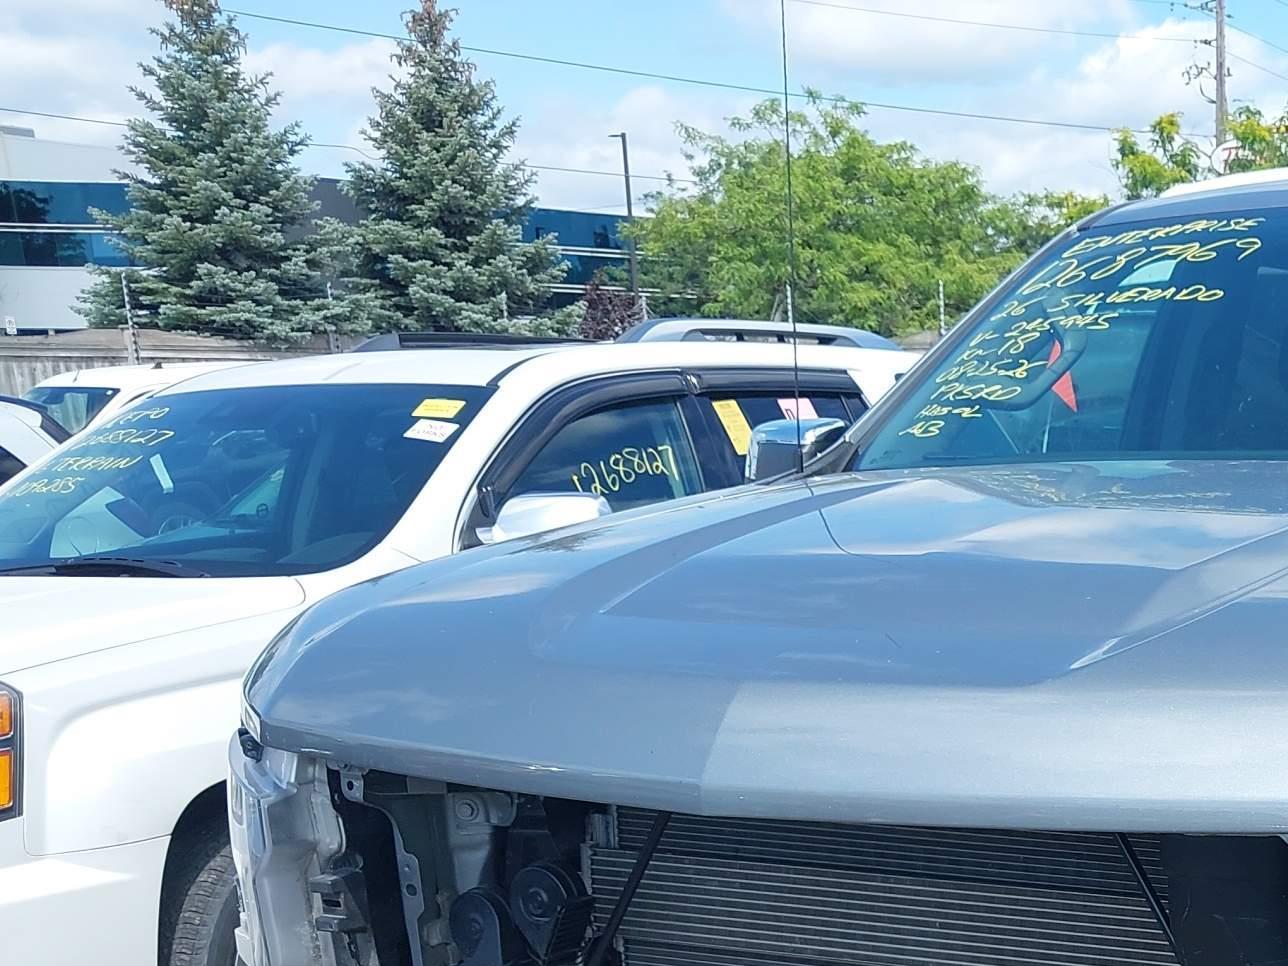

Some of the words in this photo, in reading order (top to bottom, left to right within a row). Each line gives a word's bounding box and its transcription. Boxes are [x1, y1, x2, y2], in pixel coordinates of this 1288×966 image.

[1061, 217, 1266, 258] ENTERPRISE
[1018, 238, 1262, 296] 12687969
[1047, 285, 1224, 312] SILVERADO
[572, 445, 679, 497] 12688127
